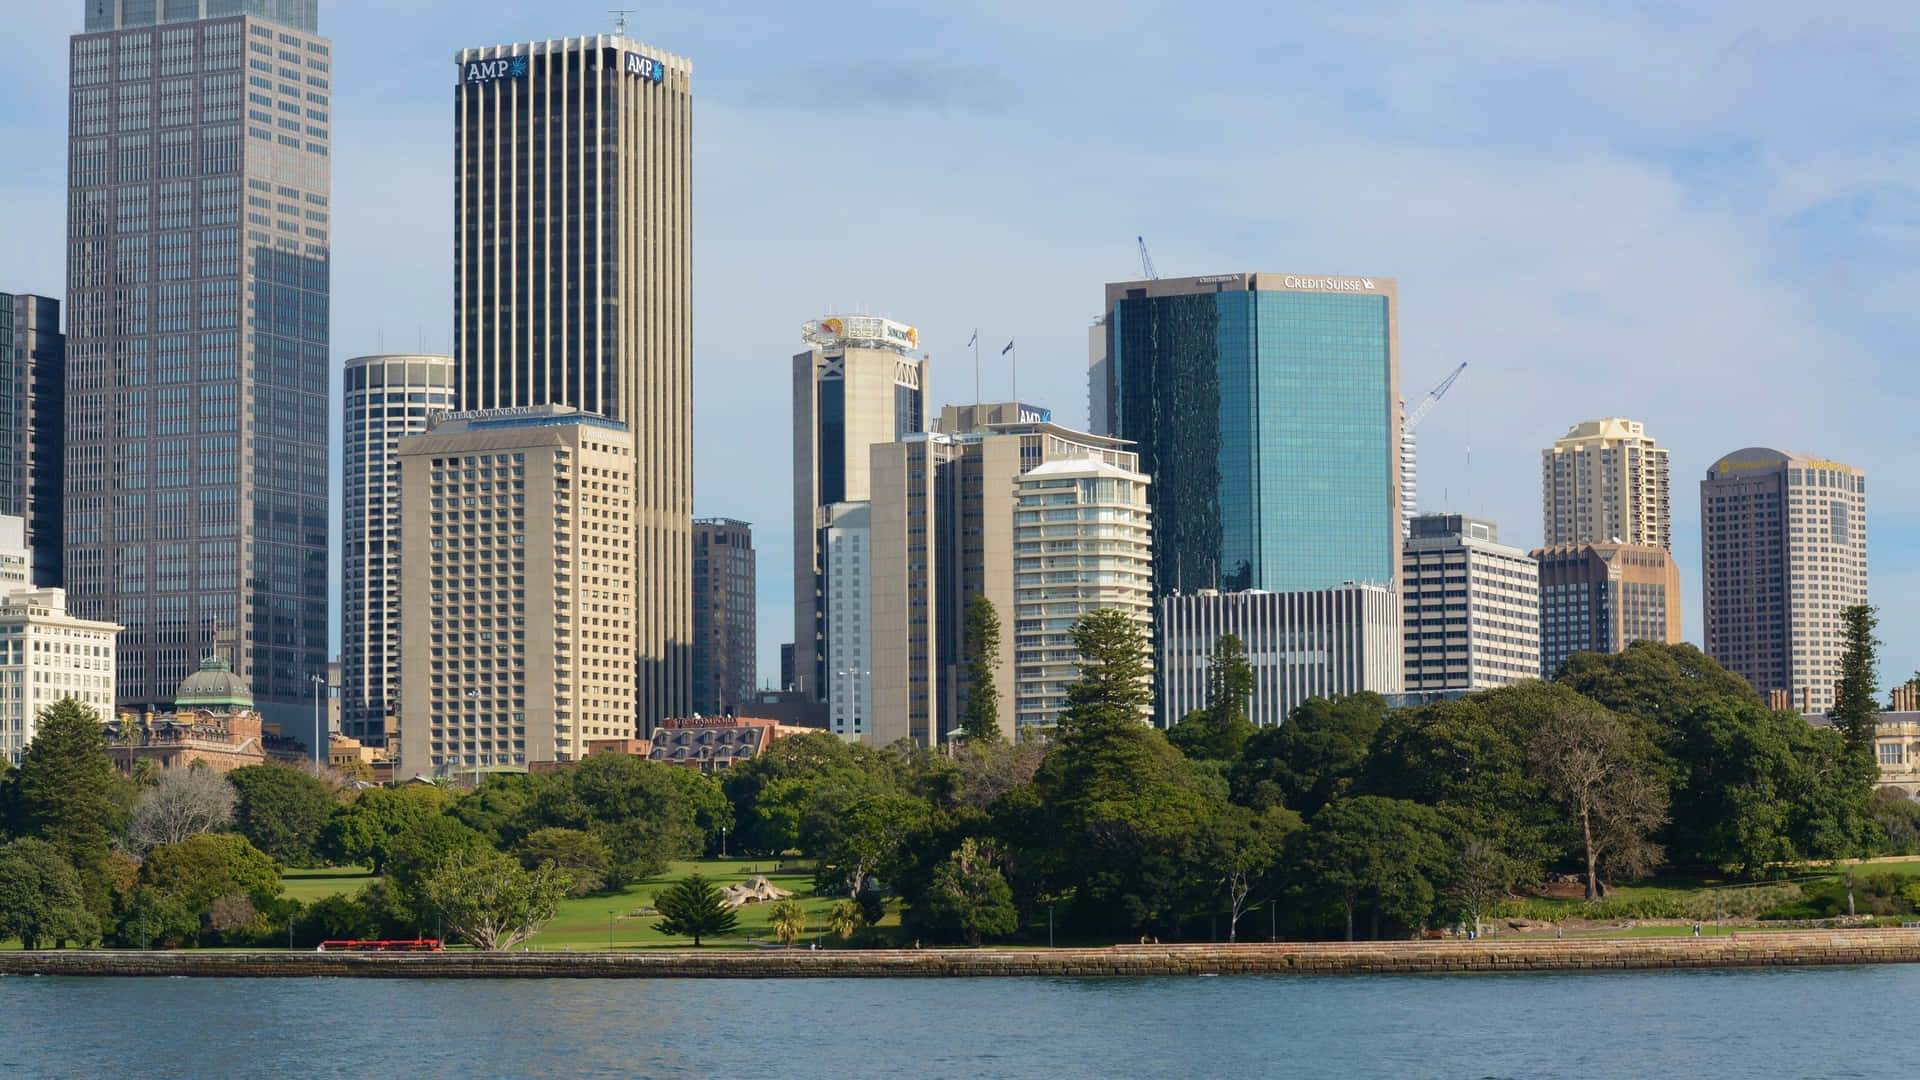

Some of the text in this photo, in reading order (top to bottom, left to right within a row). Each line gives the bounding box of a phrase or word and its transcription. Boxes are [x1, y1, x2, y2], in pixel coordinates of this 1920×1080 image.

[467, 60, 509, 80] AMP
[628, 55, 652, 77] AMP
[1284, 276, 1360, 291] CREDIT SUISSE
[1020, 410, 1041, 424] AMP
